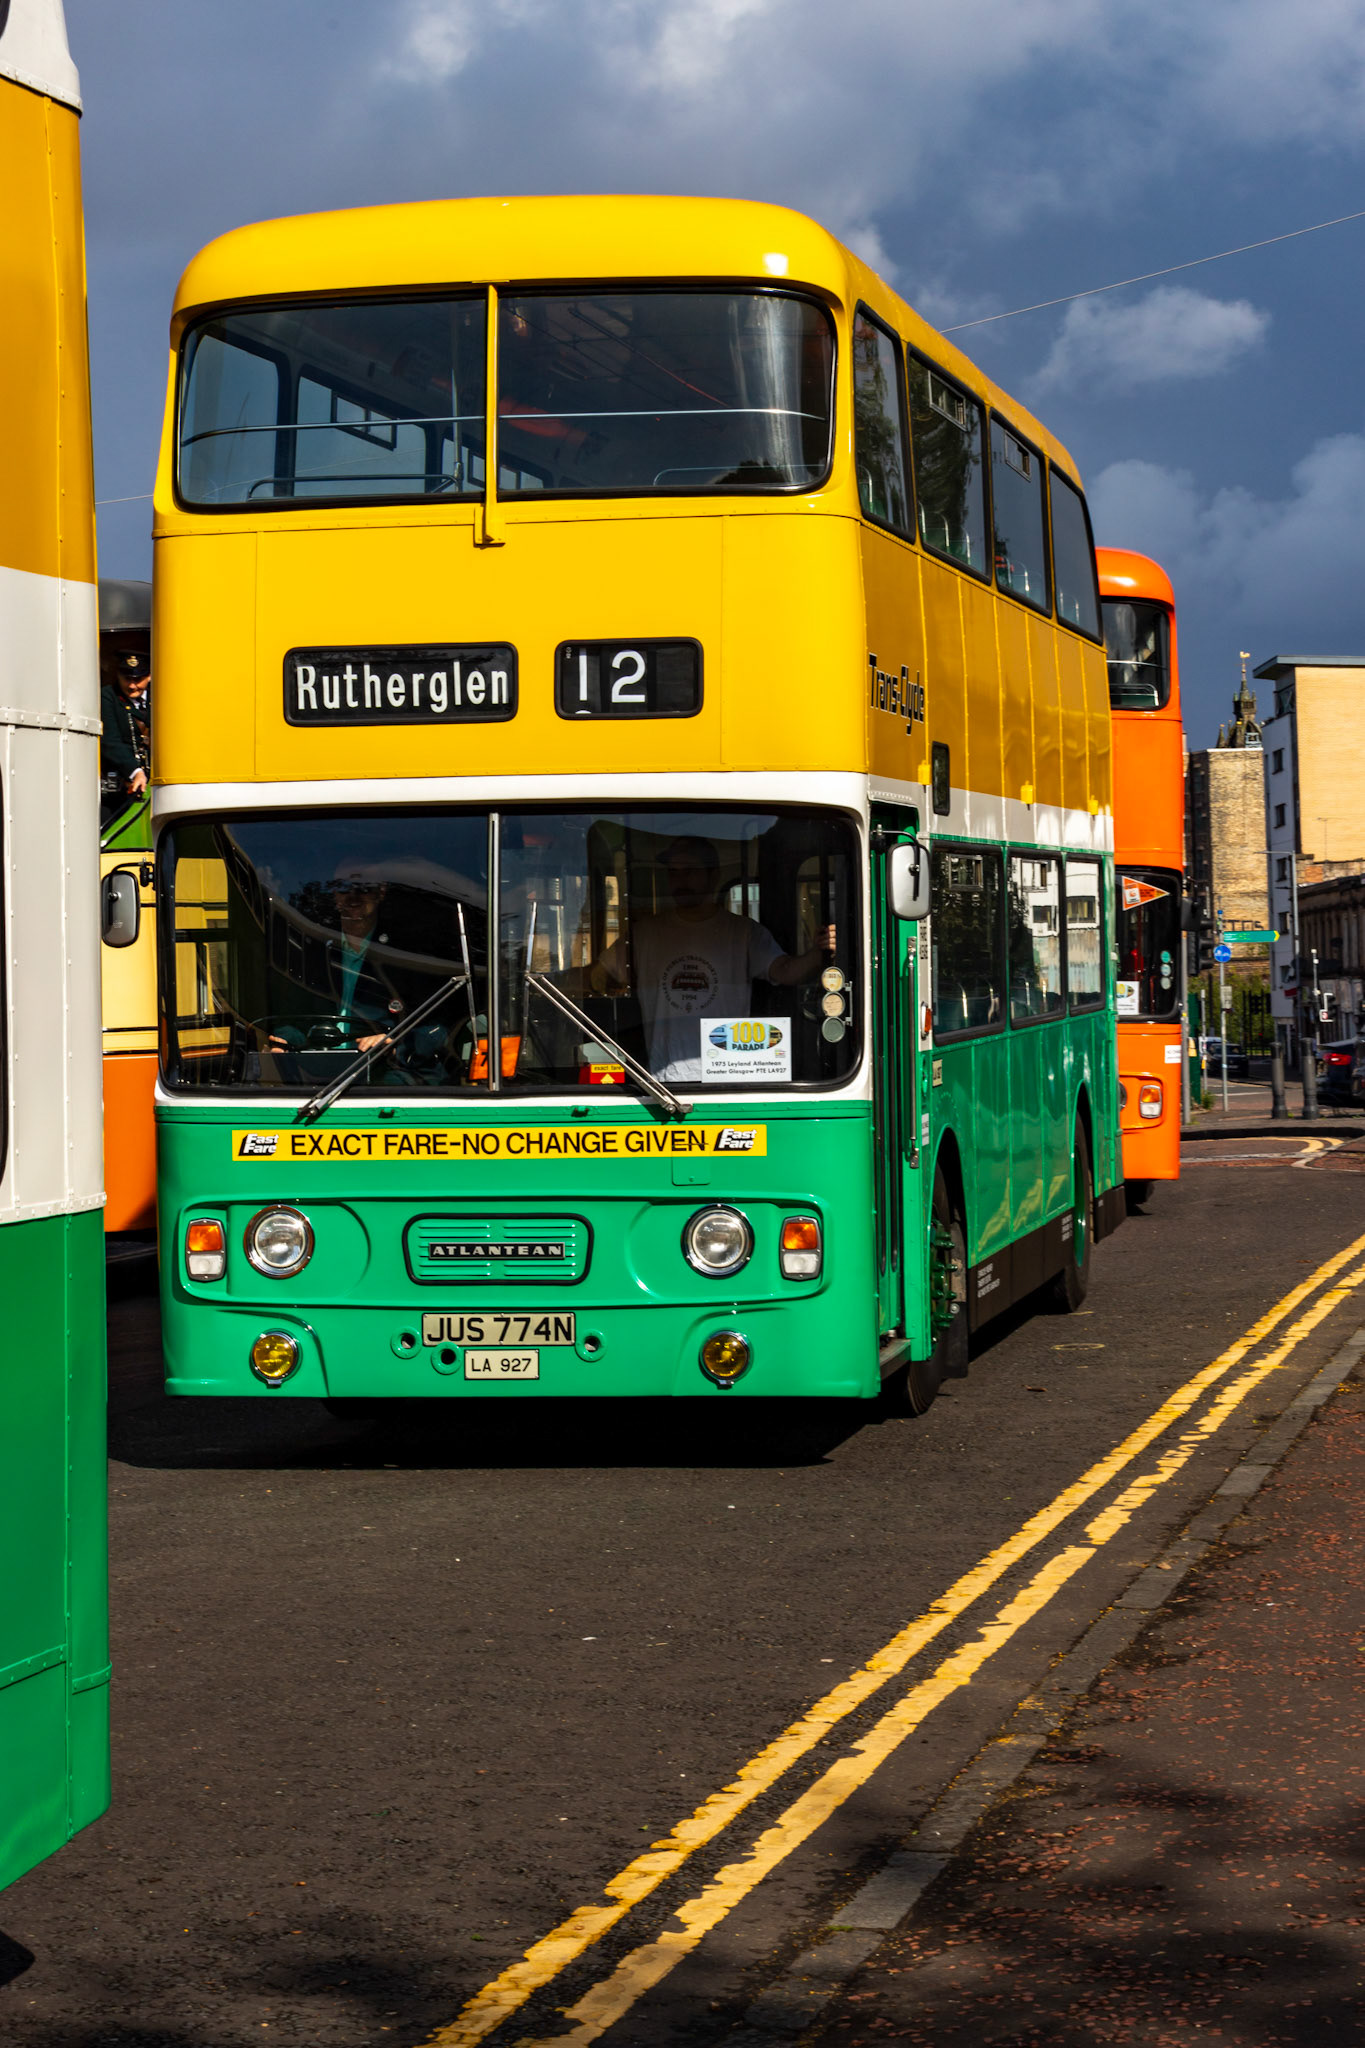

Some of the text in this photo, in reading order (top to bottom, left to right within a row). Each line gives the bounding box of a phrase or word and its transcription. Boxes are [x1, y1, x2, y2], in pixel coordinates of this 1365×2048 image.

[297, 660, 509, 713] Rutherglen
[868, 652, 924, 736] Trans-Clyde
[729, 1021, 766, 1043] 100
[732, 1043, 764, 1051] PARADE
[727, 1060, 751, 1068] Leyland
[246, 1133, 279, 1144] Fast
[721, 1128, 757, 1139] Fast
[243, 1143, 277, 1154] Fare
[291, 1134, 378, 1156] EXACT
[506, 1131, 618, 1154] CHANGE
[624, 1130, 706, 1152] GIVEN
[718, 1138, 754, 1149] Fare
[433, 1245, 562, 1256] ATLANTEAN
[427, 1316, 572, 1342] JUS 774N
[471, 1358, 531, 1372] LA 927
